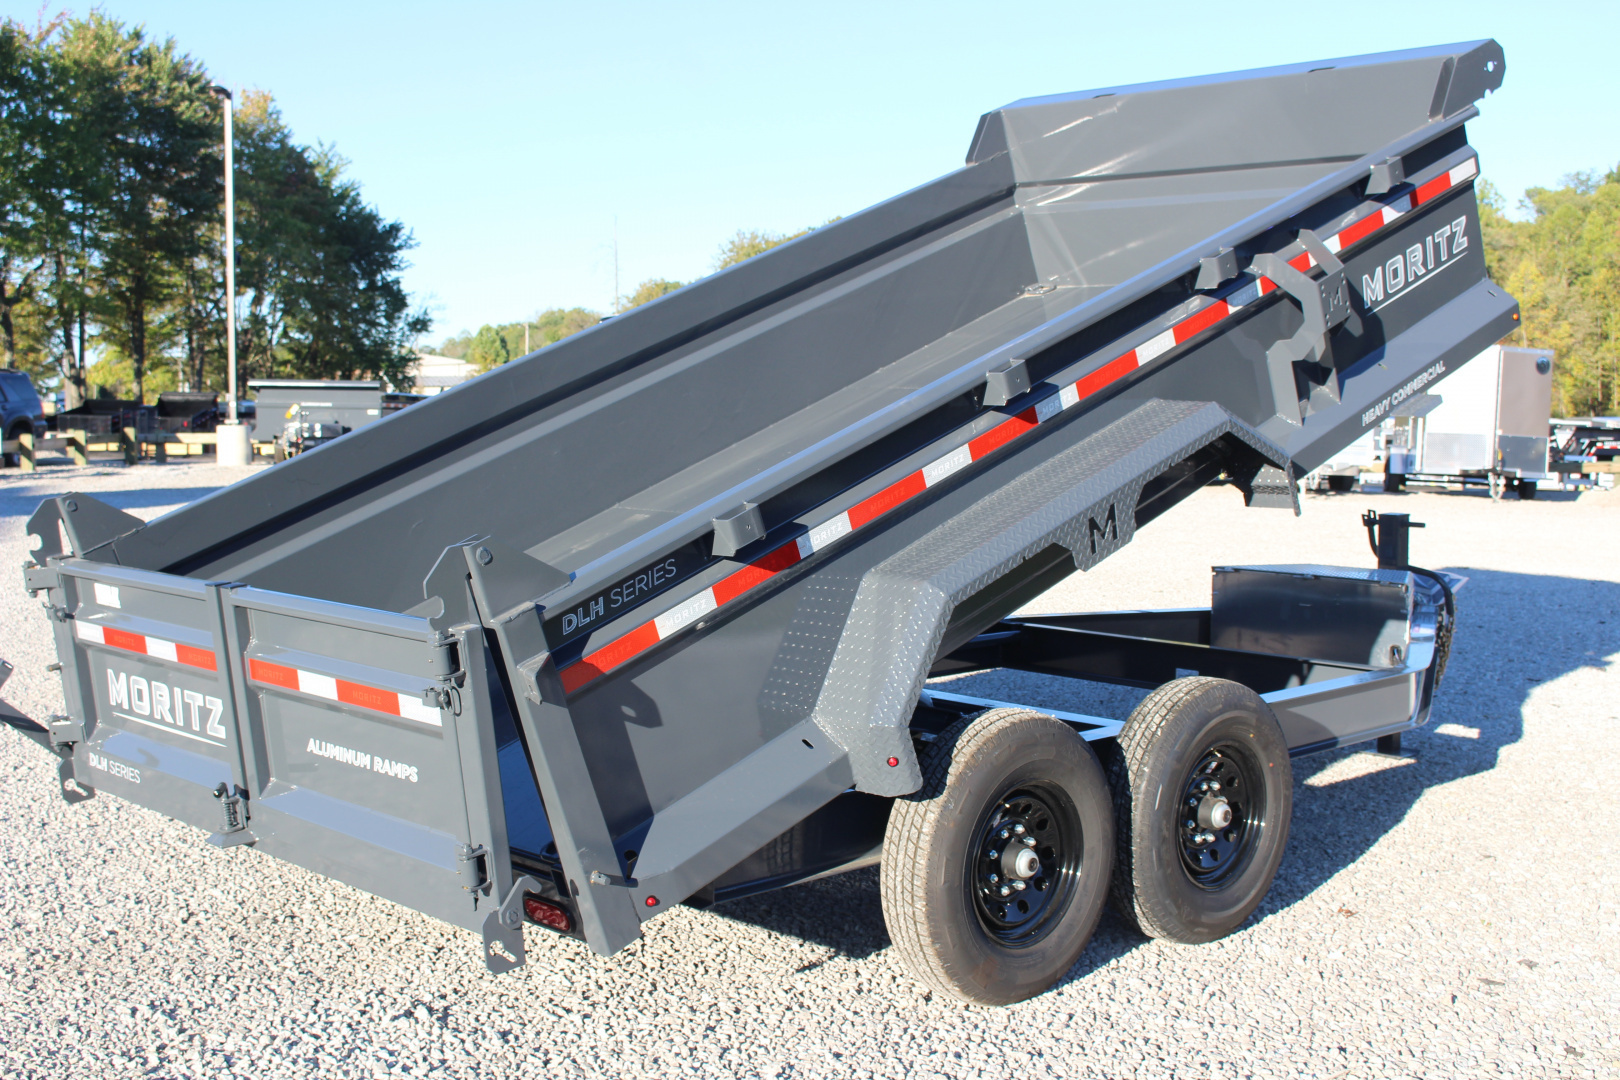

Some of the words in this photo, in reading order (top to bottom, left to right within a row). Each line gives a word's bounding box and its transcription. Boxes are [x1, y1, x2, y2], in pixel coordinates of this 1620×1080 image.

[1362, 215, 1468, 309] MORITZ
[1042, 390, 1073, 414] MORITZ
[1361, 396, 1391, 427] HEAVY
[1391, 360, 1446, 406] COMMERCIAL
[930, 452, 965, 477] MORITZ
[870, 487, 906, 513] MORITZ
[805, 521, 843, 549] MORITZ
[1088, 502, 1119, 556] M
[562, 596, 604, 636] DLH
[610, 558, 677, 608] SERIES
[665, 598, 707, 629] MORITZ
[107, 668, 227, 740] MORITZ
[352, 690, 382, 706] MORITZ
[88, 752, 108, 772] DLH
[109, 760, 141, 784] SERIES
[306, 737, 371, 770] ALUMINUM
[373, 755, 419, 783] RAMPS
